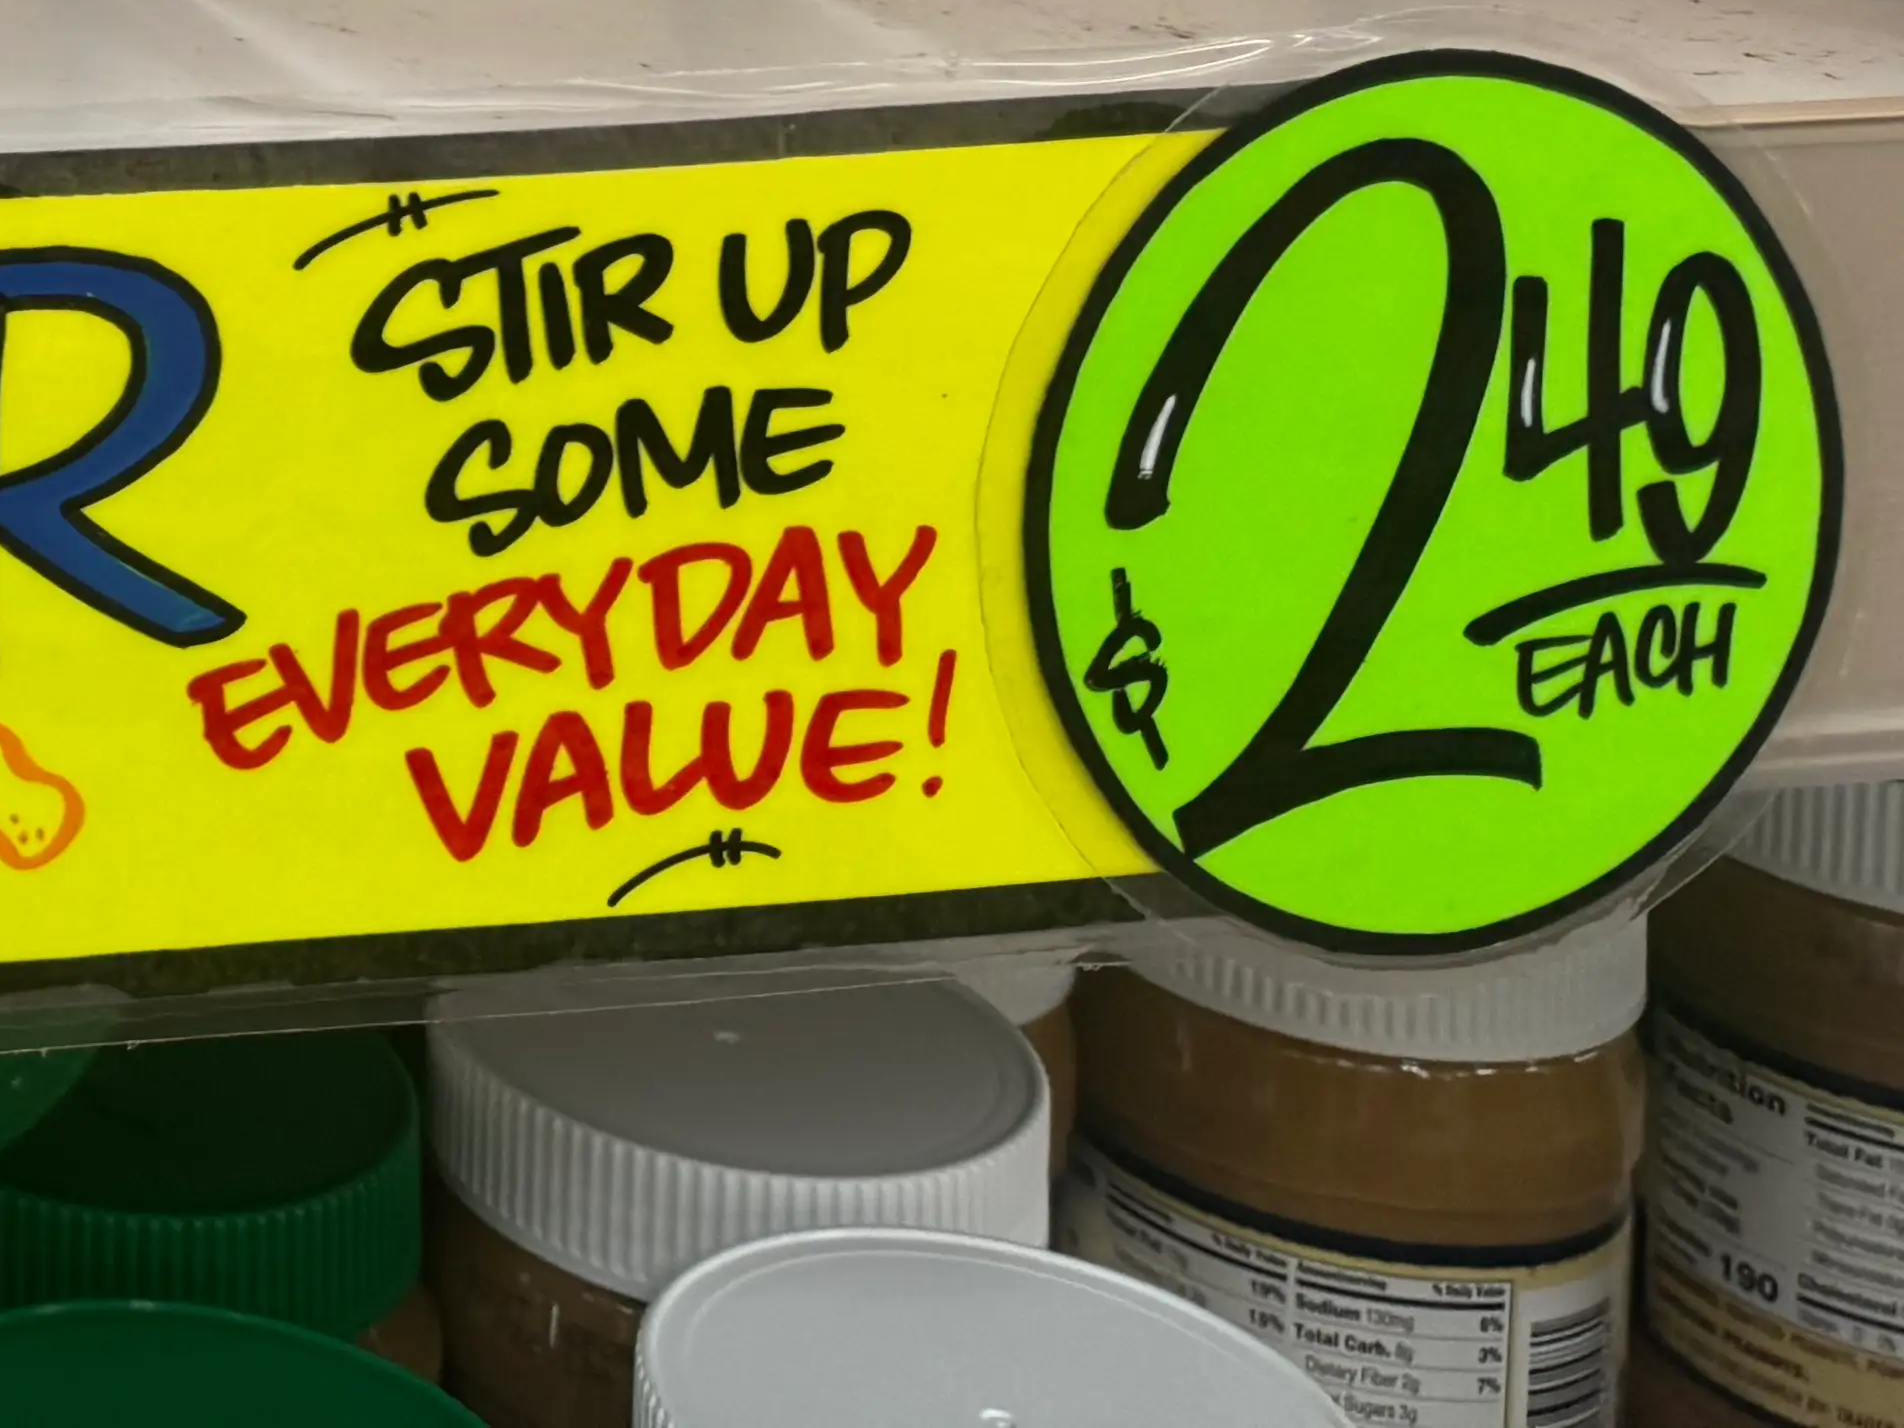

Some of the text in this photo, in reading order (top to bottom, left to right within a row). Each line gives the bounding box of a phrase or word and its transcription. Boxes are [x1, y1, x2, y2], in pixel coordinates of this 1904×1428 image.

[349, 206, 914, 405] STIR UP
[424, 386, 846, 558] SOME
[186, 524, 939, 773] EVERYDAY
[1514, 602, 1735, 719] EACH
[403, 647, 959, 865] VALUE!
[1718, 1252, 1778, 1304] 190
